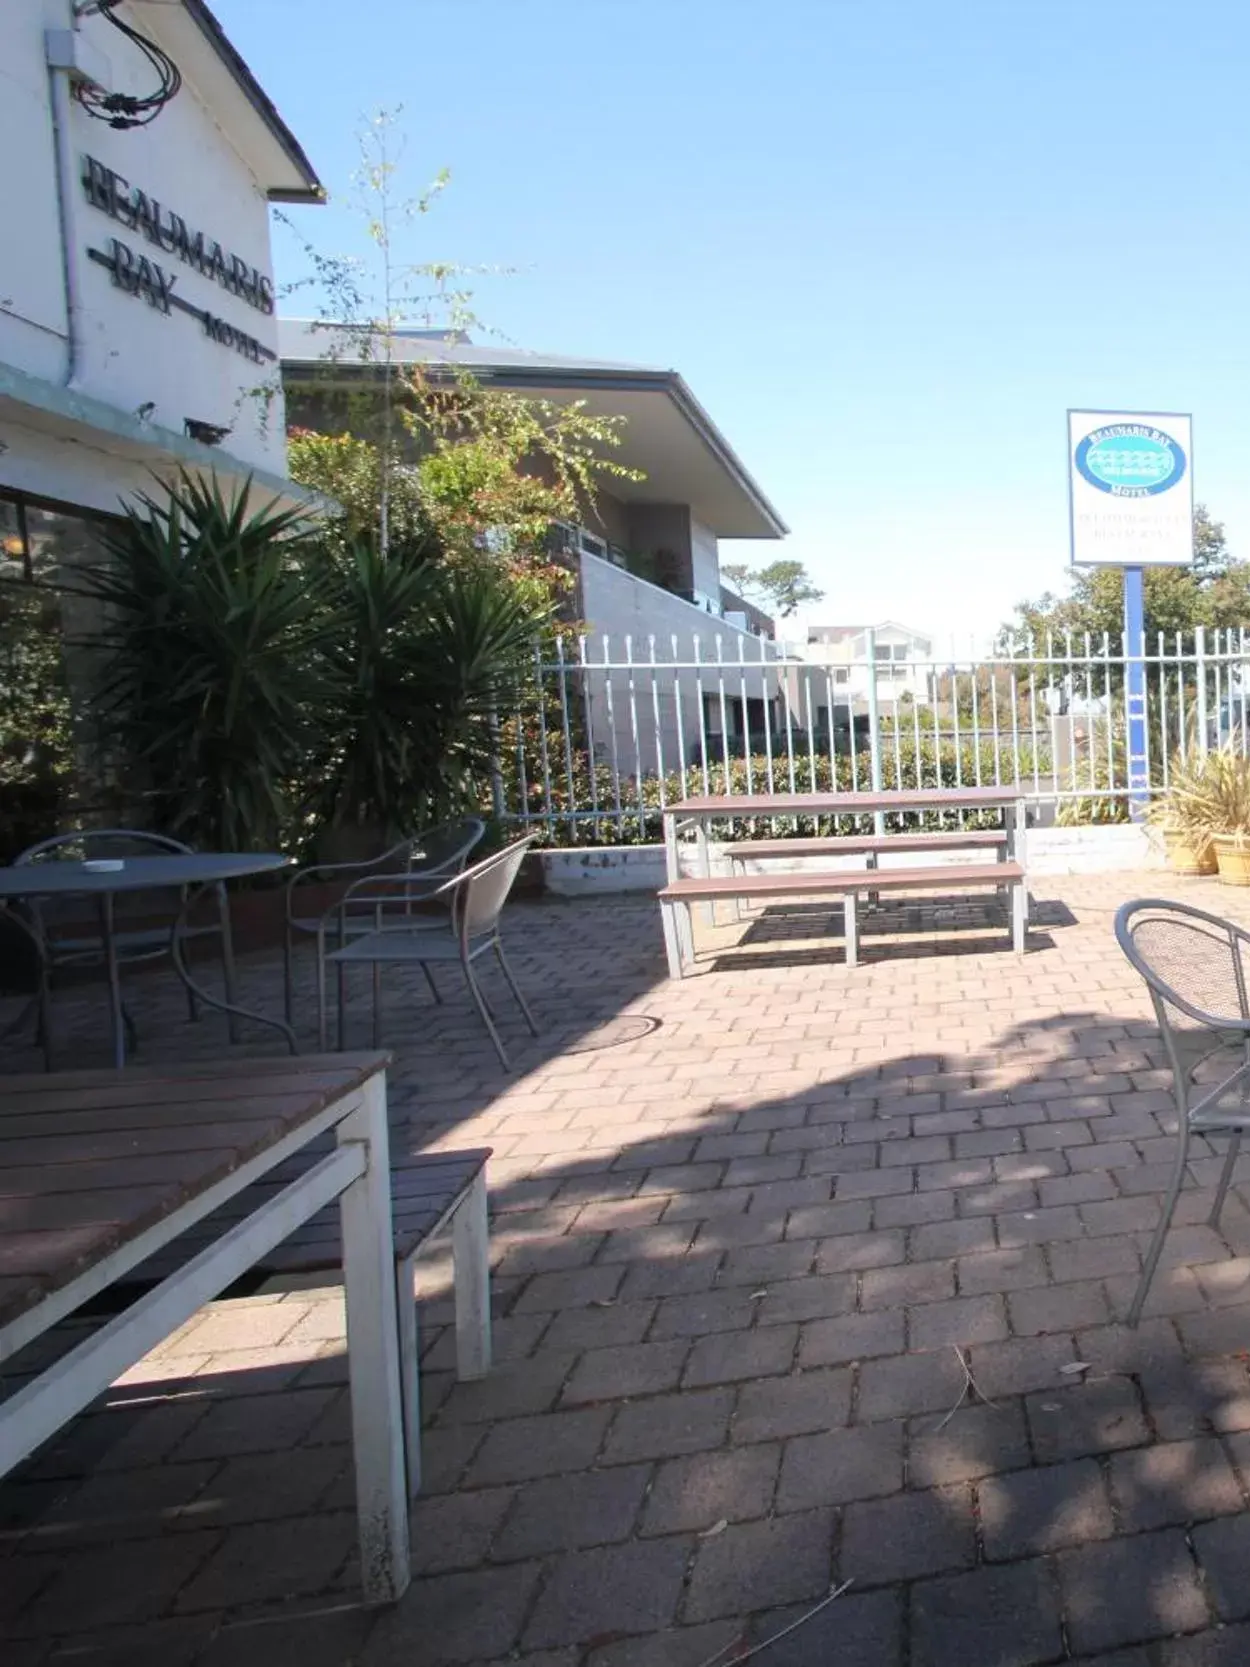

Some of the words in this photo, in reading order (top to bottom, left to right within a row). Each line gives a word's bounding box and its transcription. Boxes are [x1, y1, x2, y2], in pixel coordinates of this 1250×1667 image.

[84, 154, 273, 315] BEAUMARIS
[110, 238, 177, 316] BAY
[1088, 426, 1149, 443] BEAUMARIS
[1152, 430, 1171, 447] BAY
